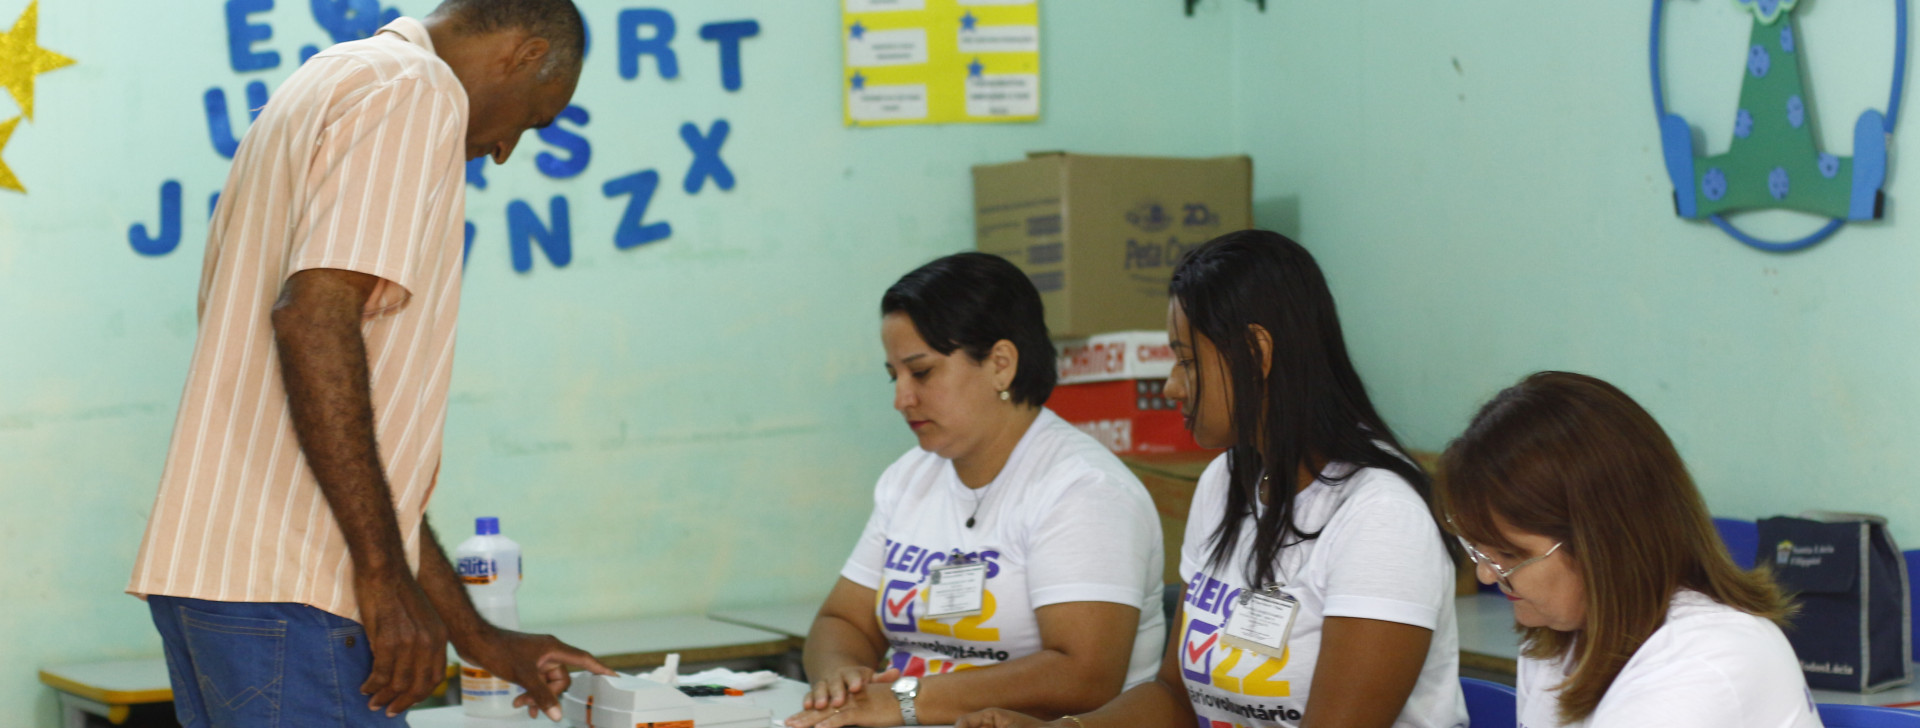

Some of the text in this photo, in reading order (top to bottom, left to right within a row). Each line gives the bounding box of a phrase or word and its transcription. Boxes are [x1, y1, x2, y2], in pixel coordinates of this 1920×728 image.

[618, 9, 679, 80] R
[699, 19, 760, 92] T
[535, 103, 592, 179] S
[680, 119, 735, 194] X
[129, 169, 672, 273] J N Z
